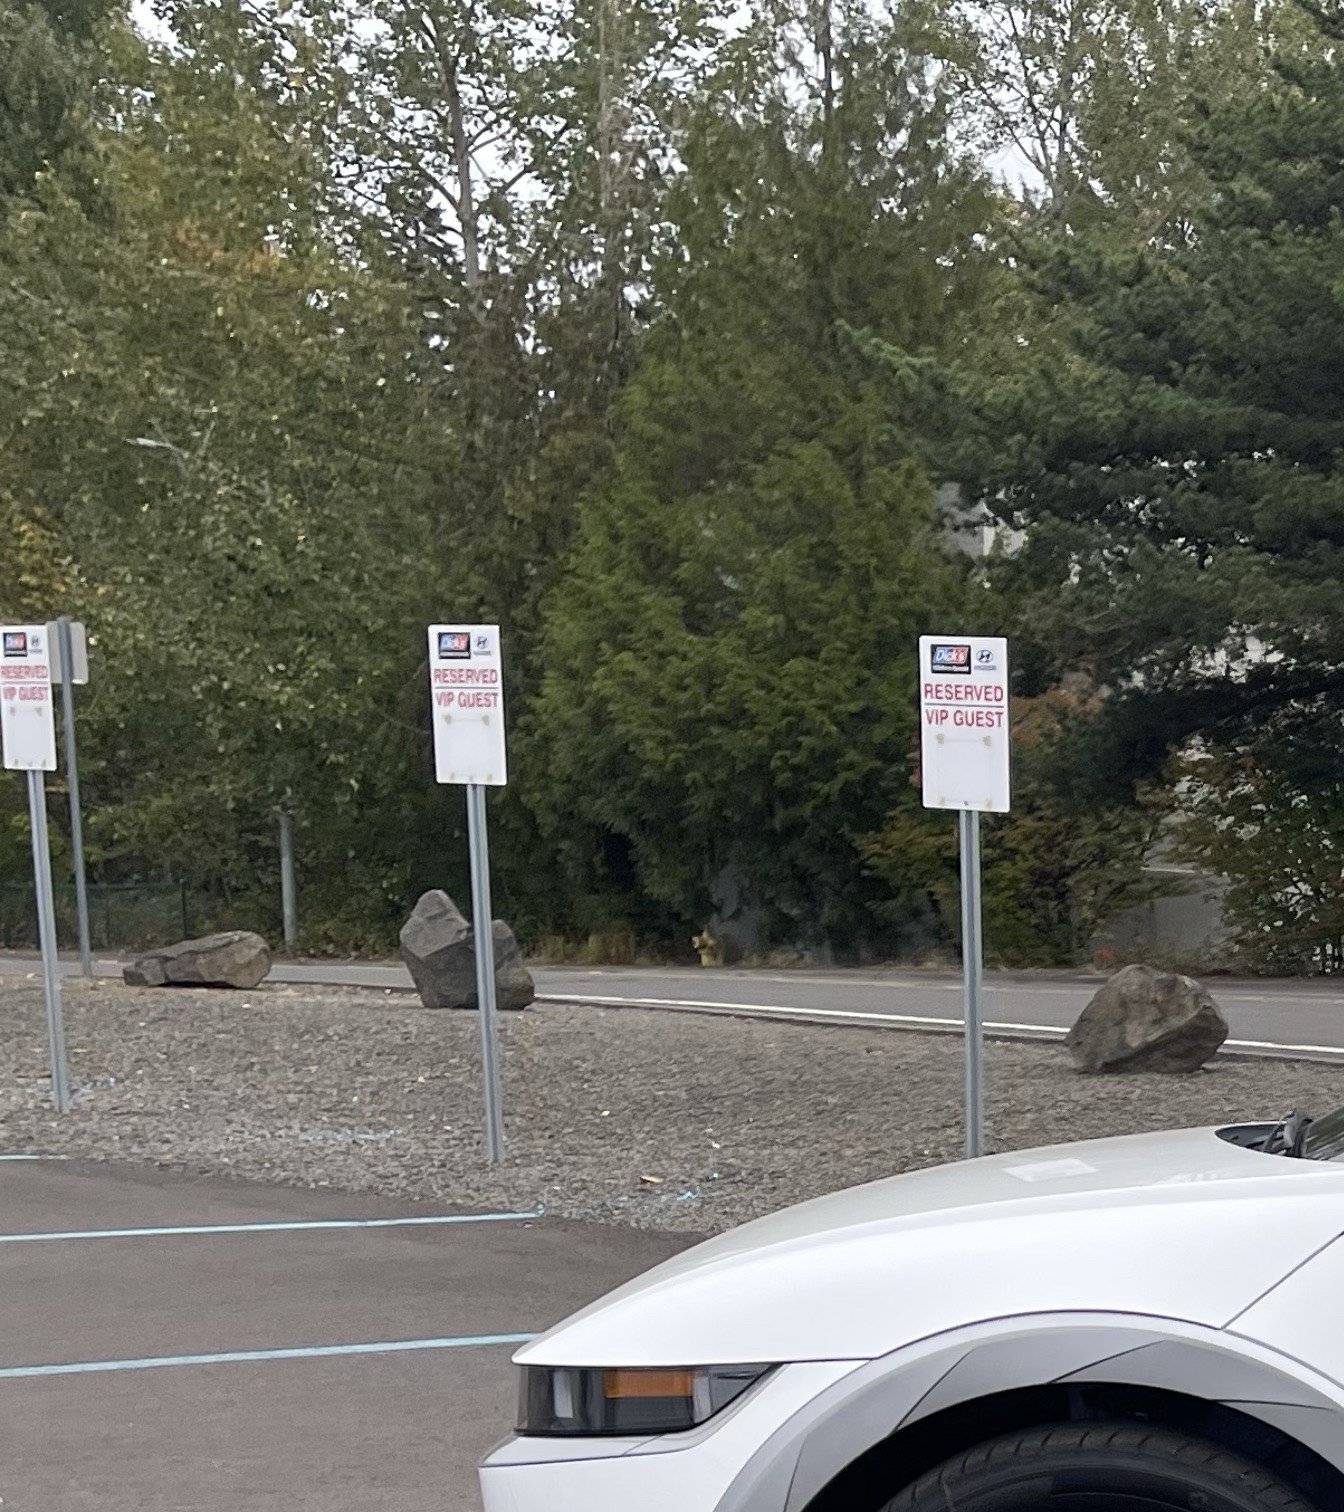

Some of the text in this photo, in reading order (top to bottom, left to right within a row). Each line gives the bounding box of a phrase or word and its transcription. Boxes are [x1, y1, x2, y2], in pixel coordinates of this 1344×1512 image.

[433, 668, 498, 684] RESERVED
[435, 691, 499, 708] VIP GUEST
[924, 683, 1004, 702] RESERVED
[925, 708, 1004, 728] VIP GUEST
